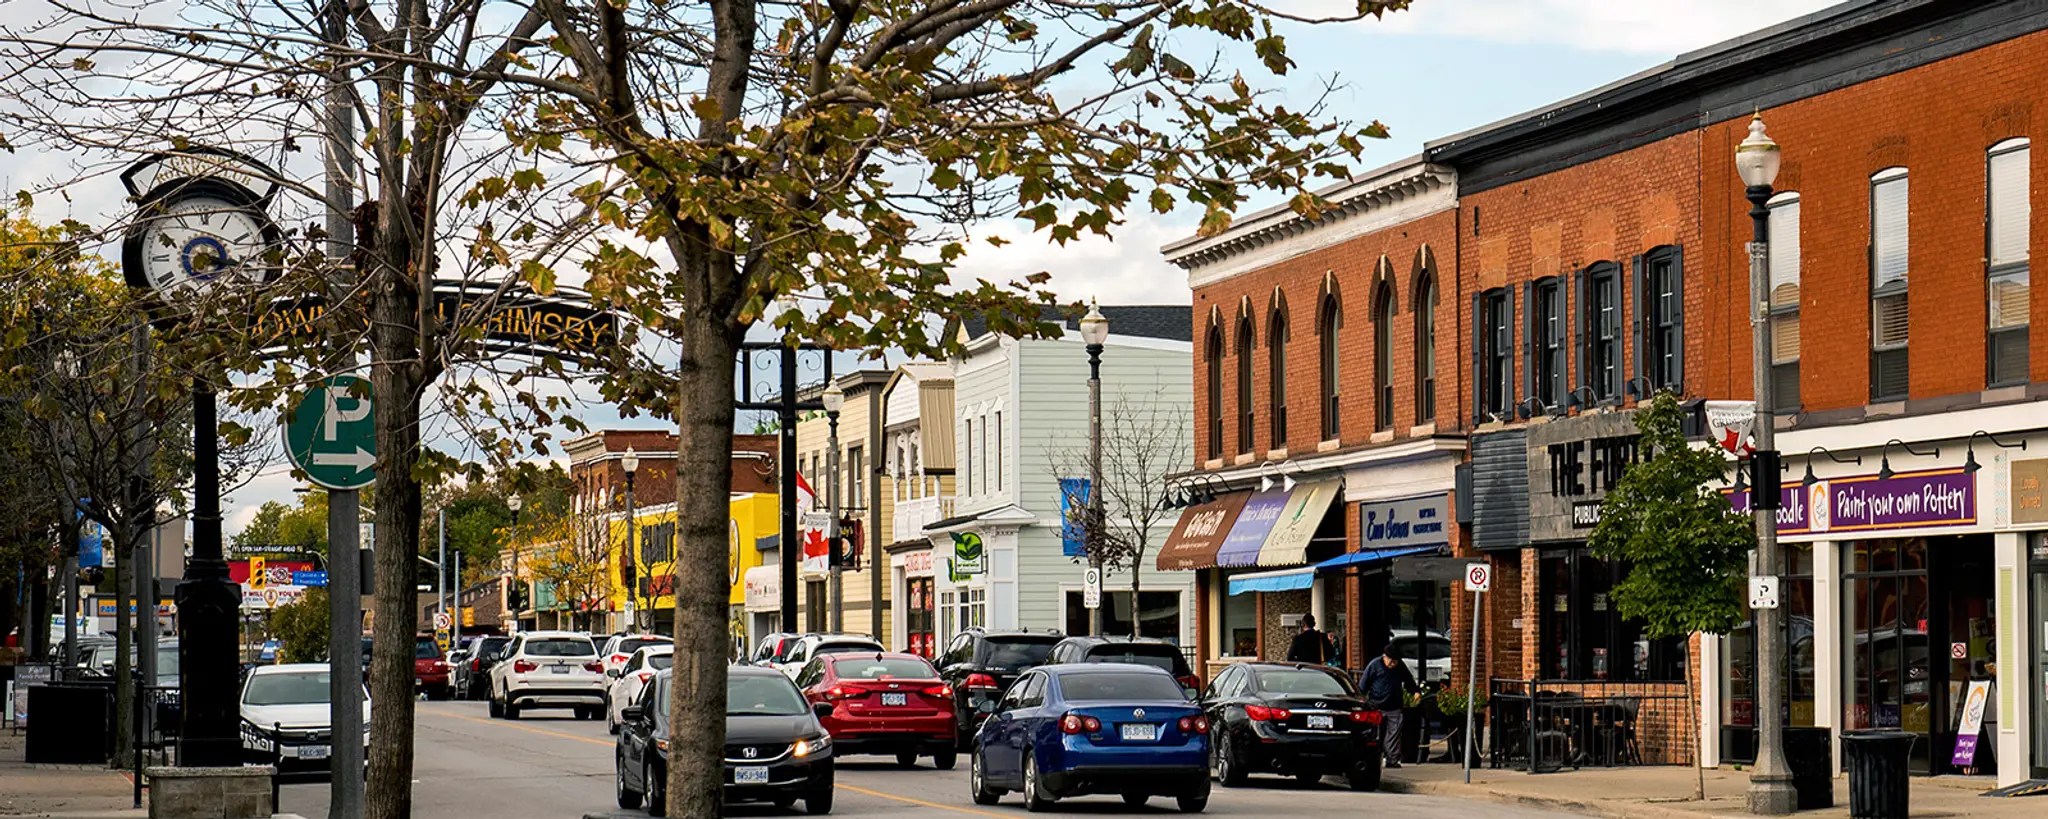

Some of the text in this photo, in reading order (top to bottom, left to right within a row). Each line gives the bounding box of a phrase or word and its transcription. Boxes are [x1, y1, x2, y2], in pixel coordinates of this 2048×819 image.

[324, 386, 372, 441] P
[1548, 440, 1585, 498] THE
[1776, 488, 1804, 524] oodle
[1868, 492, 1894, 525] your
[1896, 491, 1920, 515] own
[1923, 483, 1967, 519] Pottery
